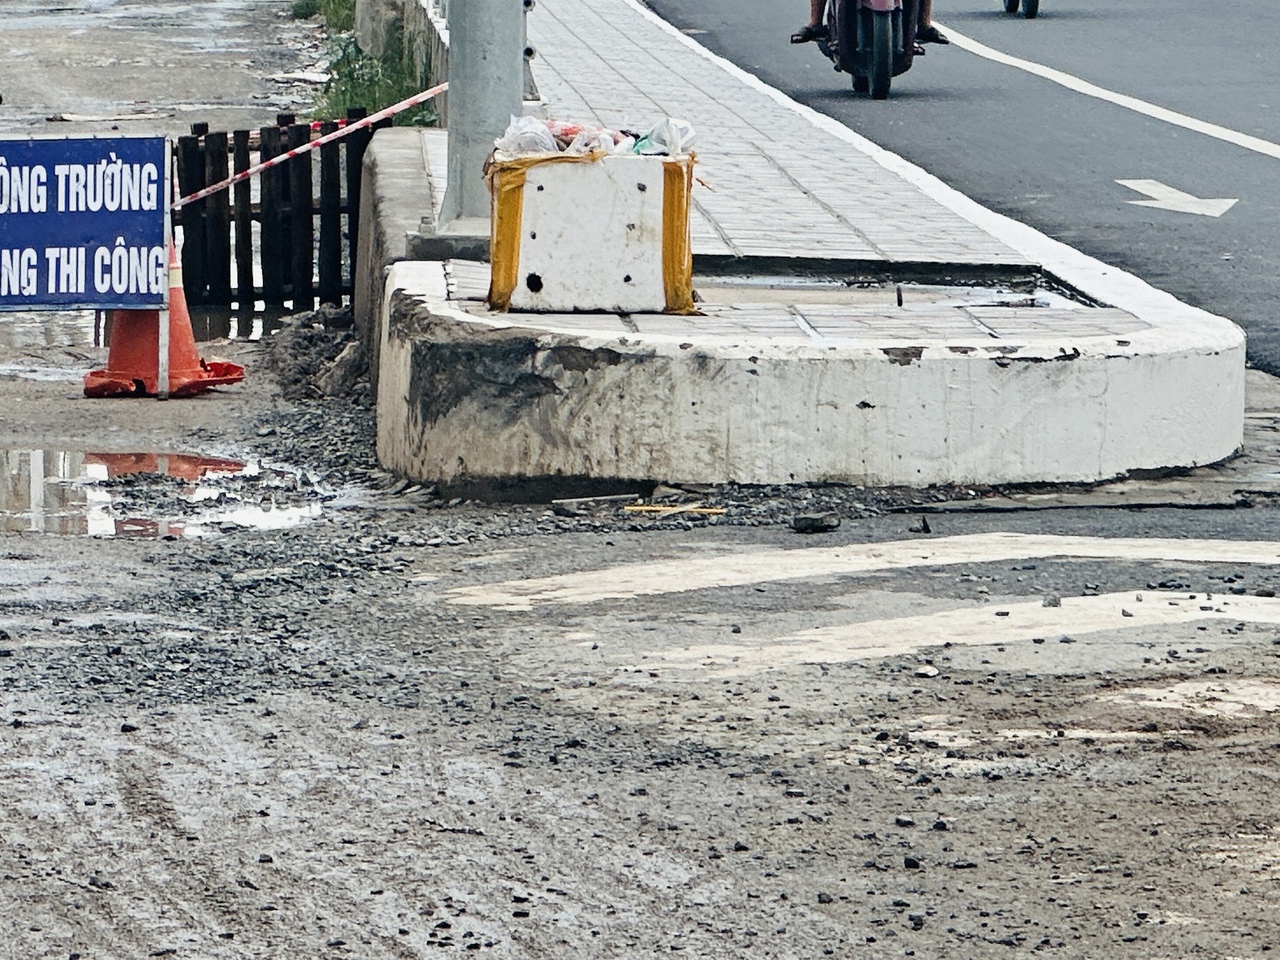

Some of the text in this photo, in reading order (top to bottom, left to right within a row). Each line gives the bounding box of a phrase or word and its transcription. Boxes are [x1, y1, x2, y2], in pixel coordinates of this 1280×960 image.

[54, 152, 159, 213] TRƯỜNG
[45, 246, 87, 294] THI
[93, 236, 164, 295] CÔNG
